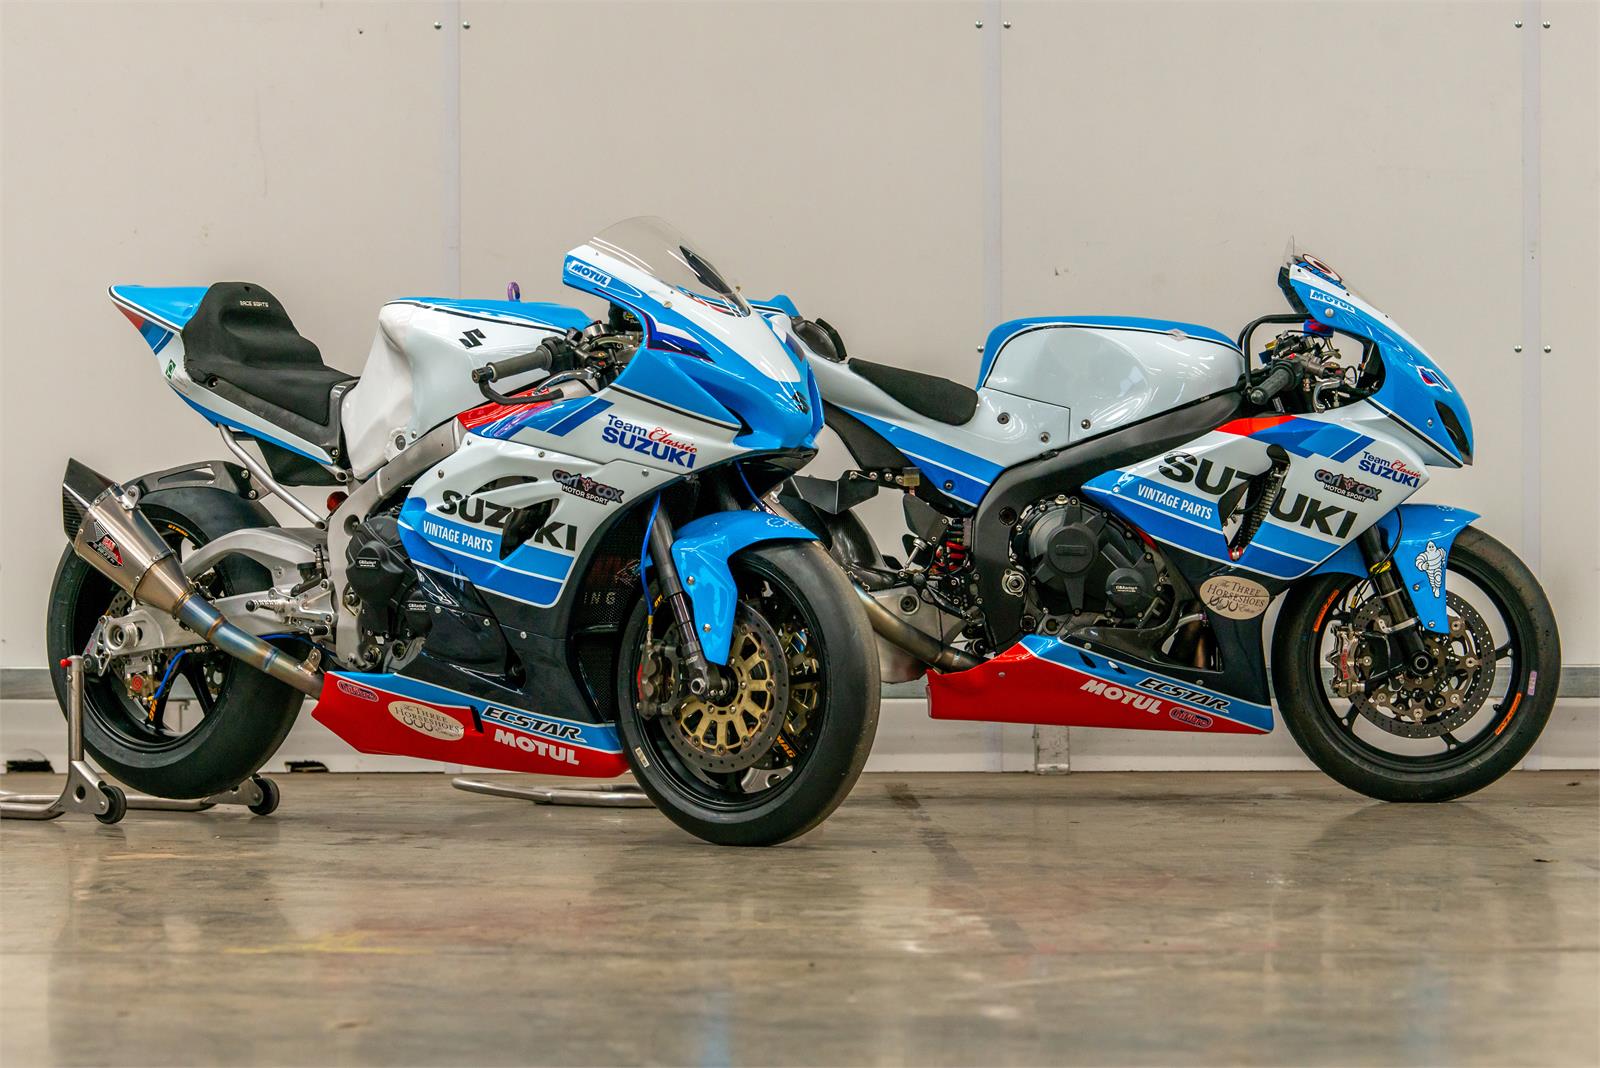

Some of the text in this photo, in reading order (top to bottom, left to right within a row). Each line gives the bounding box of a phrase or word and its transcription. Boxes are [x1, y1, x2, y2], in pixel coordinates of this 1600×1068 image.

[571, 263, 608, 285] MOTUL
[1311, 291, 1354, 312] MOTUL
[602, 426, 696, 469] SUZUKI
[608, 414, 697, 453] Team Classic
[1358, 459, 1420, 488] SUZUKI
[1363, 451, 1391, 468] Team
[562, 485, 608, 505] MOTOR SPORT
[1137, 483, 1213, 520] VINTAGE PARTS
[1324, 484, 1367, 502] MOTOR SPORT
[436, 490, 578, 551] SUZKI
[423, 520, 494, 553] VINTAGE PARTS
[1207, 584, 1265, 608] HORSESHOES
[1231, 581, 1261, 597] THREE
[1080, 679, 1163, 714] MOTUL
[1138, 677, 1229, 713] ECSTAR
[395, 707, 460, 733] HORSESHOES
[483, 706, 584, 741] ECSTAR
[494, 728, 580, 766] MOTUL
